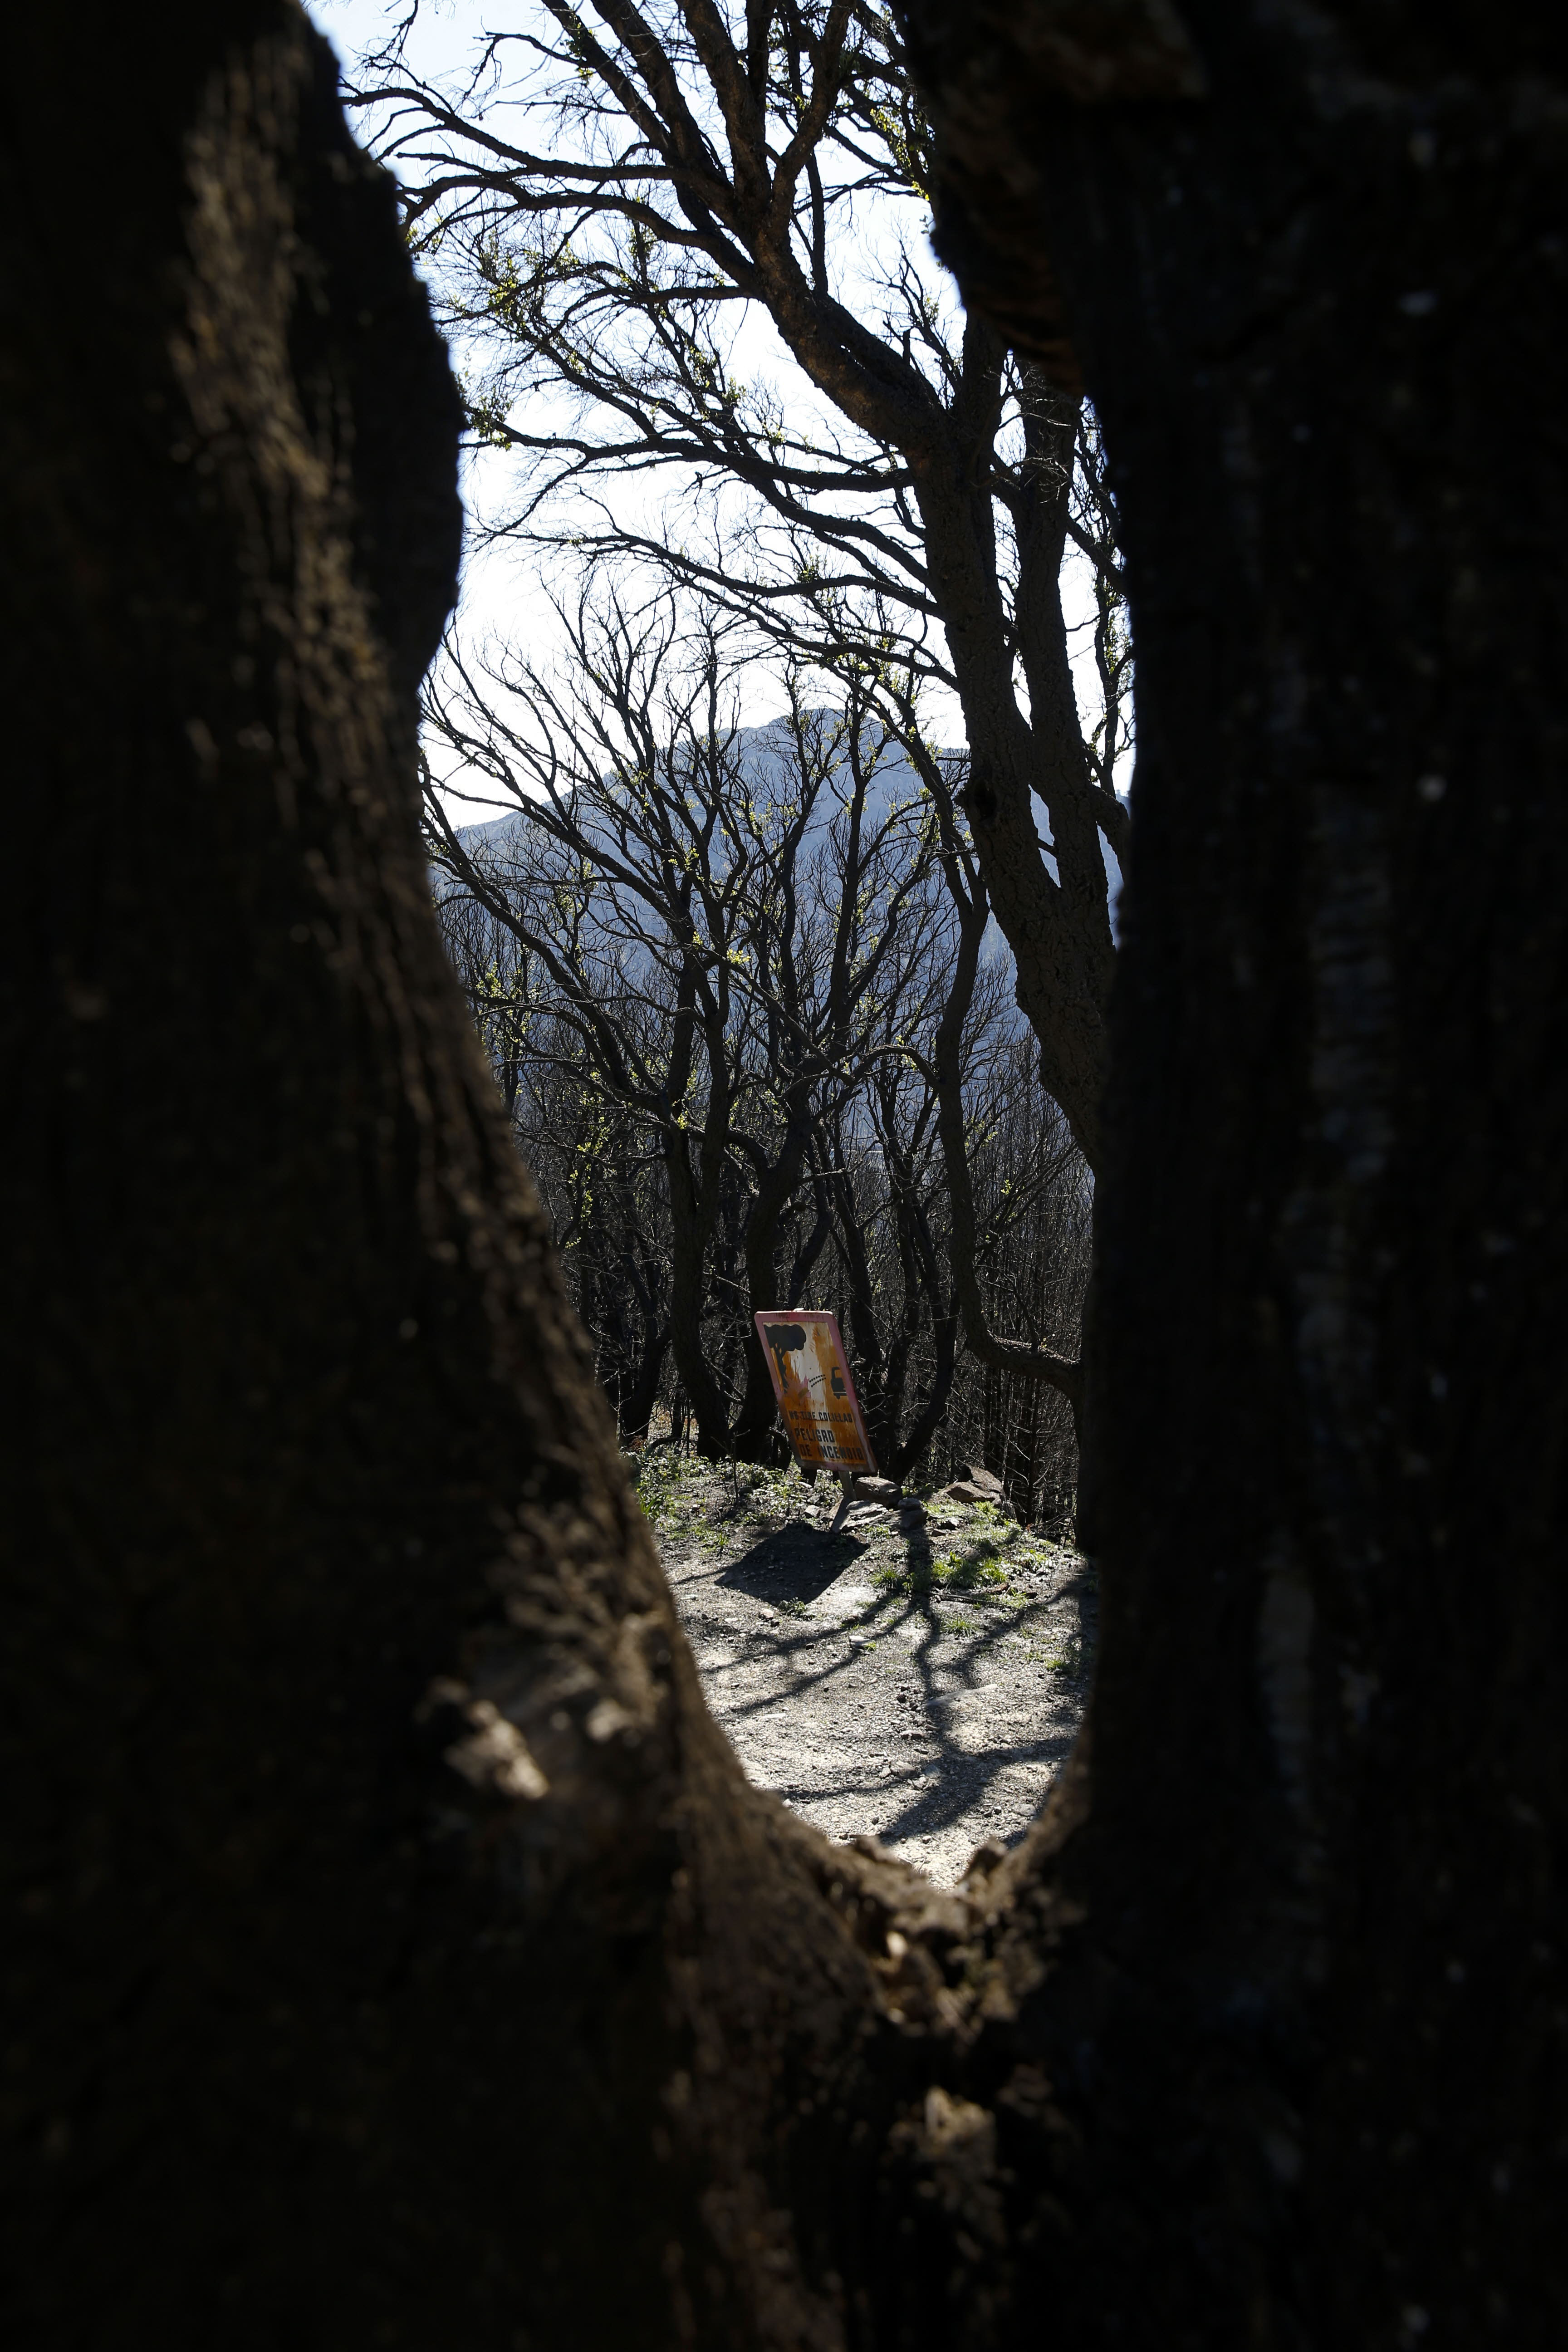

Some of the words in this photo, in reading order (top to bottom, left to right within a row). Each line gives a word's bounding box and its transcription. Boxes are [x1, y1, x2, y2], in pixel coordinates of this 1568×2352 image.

[818, 1411, 853, 1422] COLILLAS
[794, 1428, 835, 1443] PELIGRO
[799, 1444, 812, 1456] DE
[817, 1445, 864, 1460] INCENDIO
